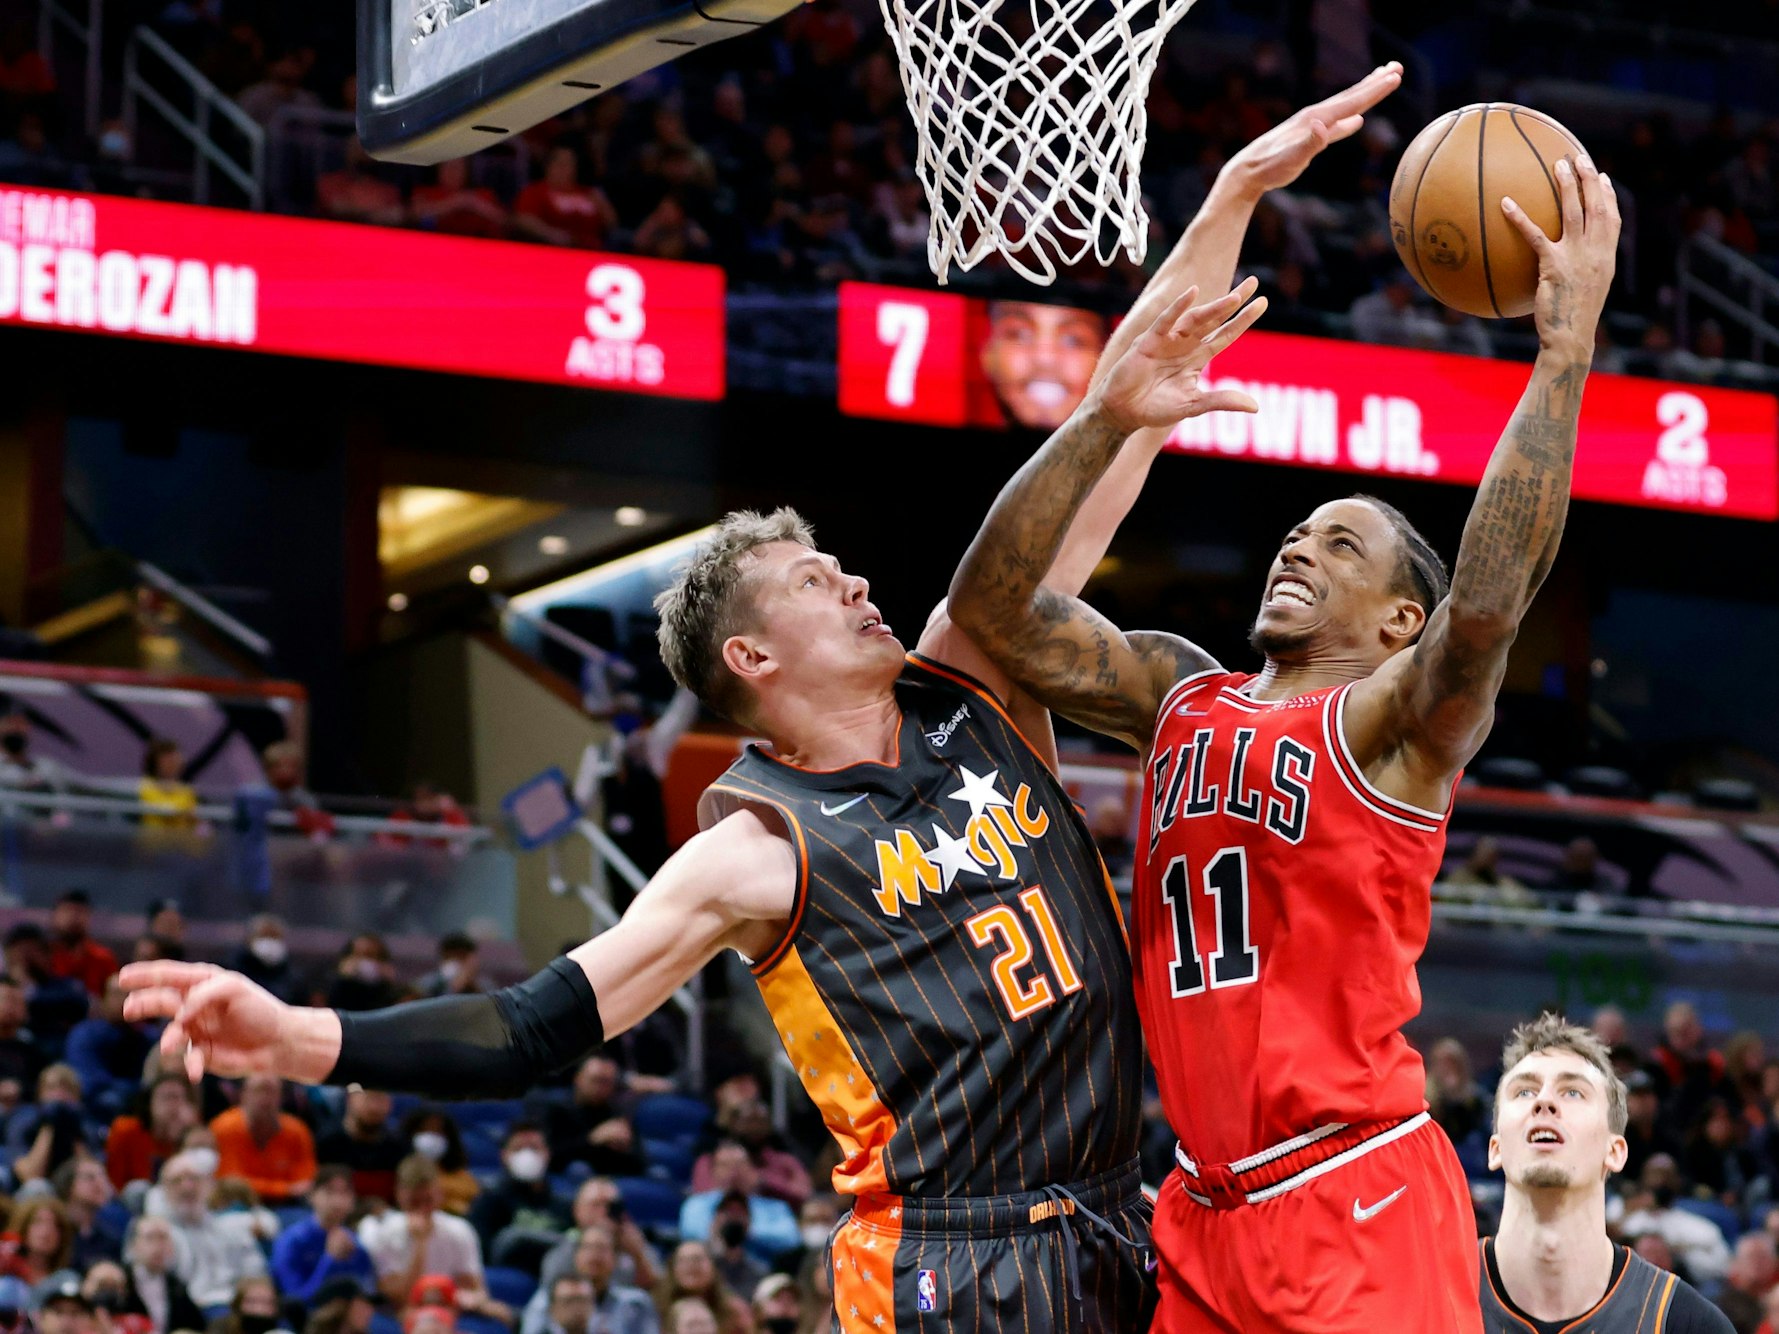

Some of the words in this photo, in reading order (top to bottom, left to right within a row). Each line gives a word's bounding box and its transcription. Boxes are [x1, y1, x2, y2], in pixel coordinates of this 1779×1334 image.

[0, 190, 96, 249] EMAR
[584, 264, 646, 341] 3
[566, 336, 665, 386] ASTS
[877, 301, 931, 408] 7
[1347, 394, 1440, 476] JR.
[1656, 391, 1709, 467] 2
[1641, 458, 1728, 507] ASTS
[1147, 727, 1316, 865] BULLS
[964, 884, 1084, 1022] 21
[1161, 846, 1259, 999] 11
[1029, 1198, 1075, 1224] ORLADO
